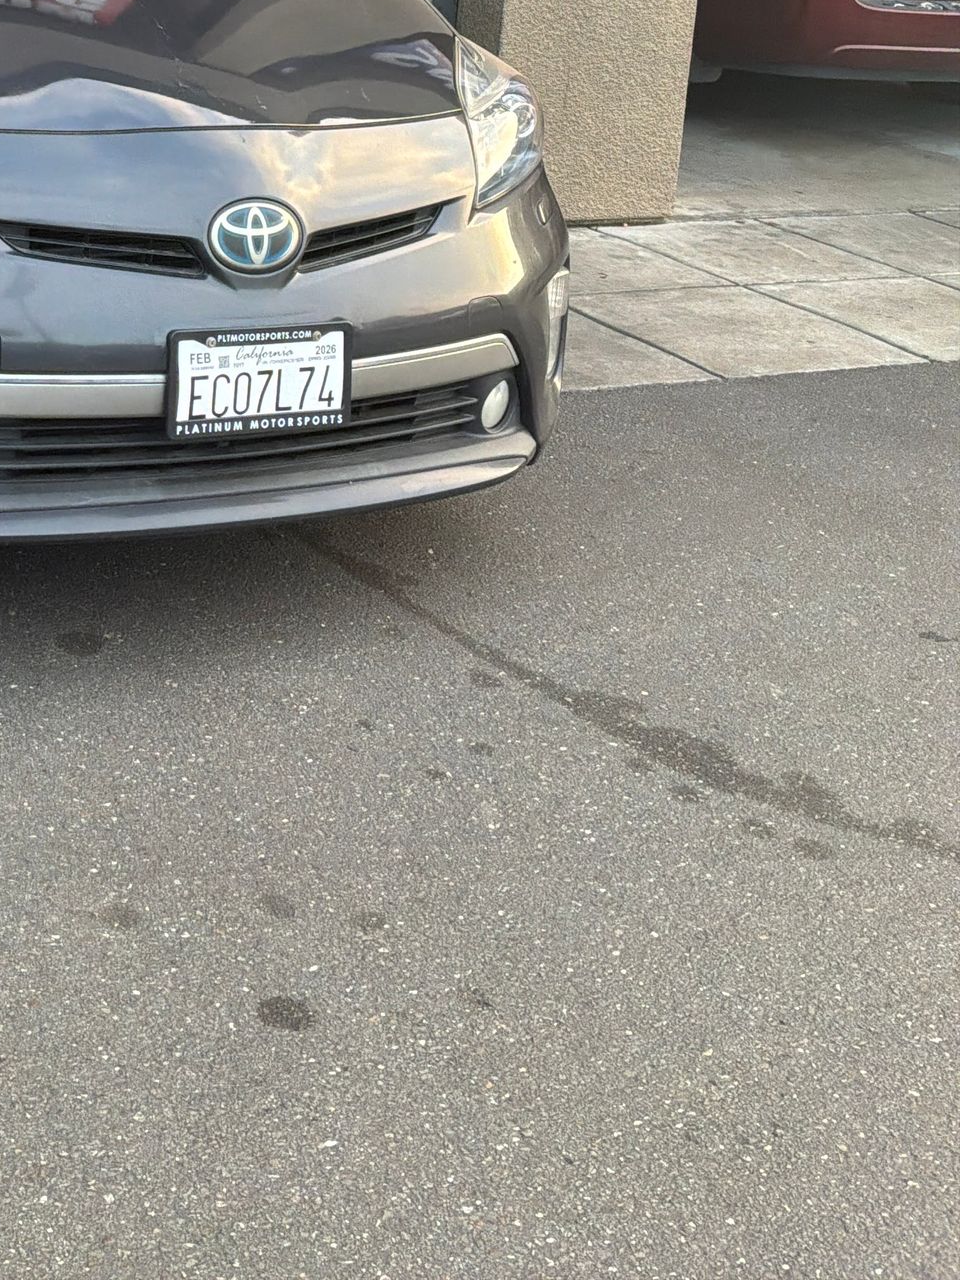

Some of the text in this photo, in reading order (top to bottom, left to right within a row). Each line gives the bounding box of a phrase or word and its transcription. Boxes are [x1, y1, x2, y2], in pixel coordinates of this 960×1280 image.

[217, 330, 312, 343] PLTMOTORSPORTS.COM
[235, 345, 294, 366] California
[315, 344, 337, 355] 2026
[190, 352, 211, 365] FEB
[176, 414, 344, 436] PLATINUM MOTORSPORTS
